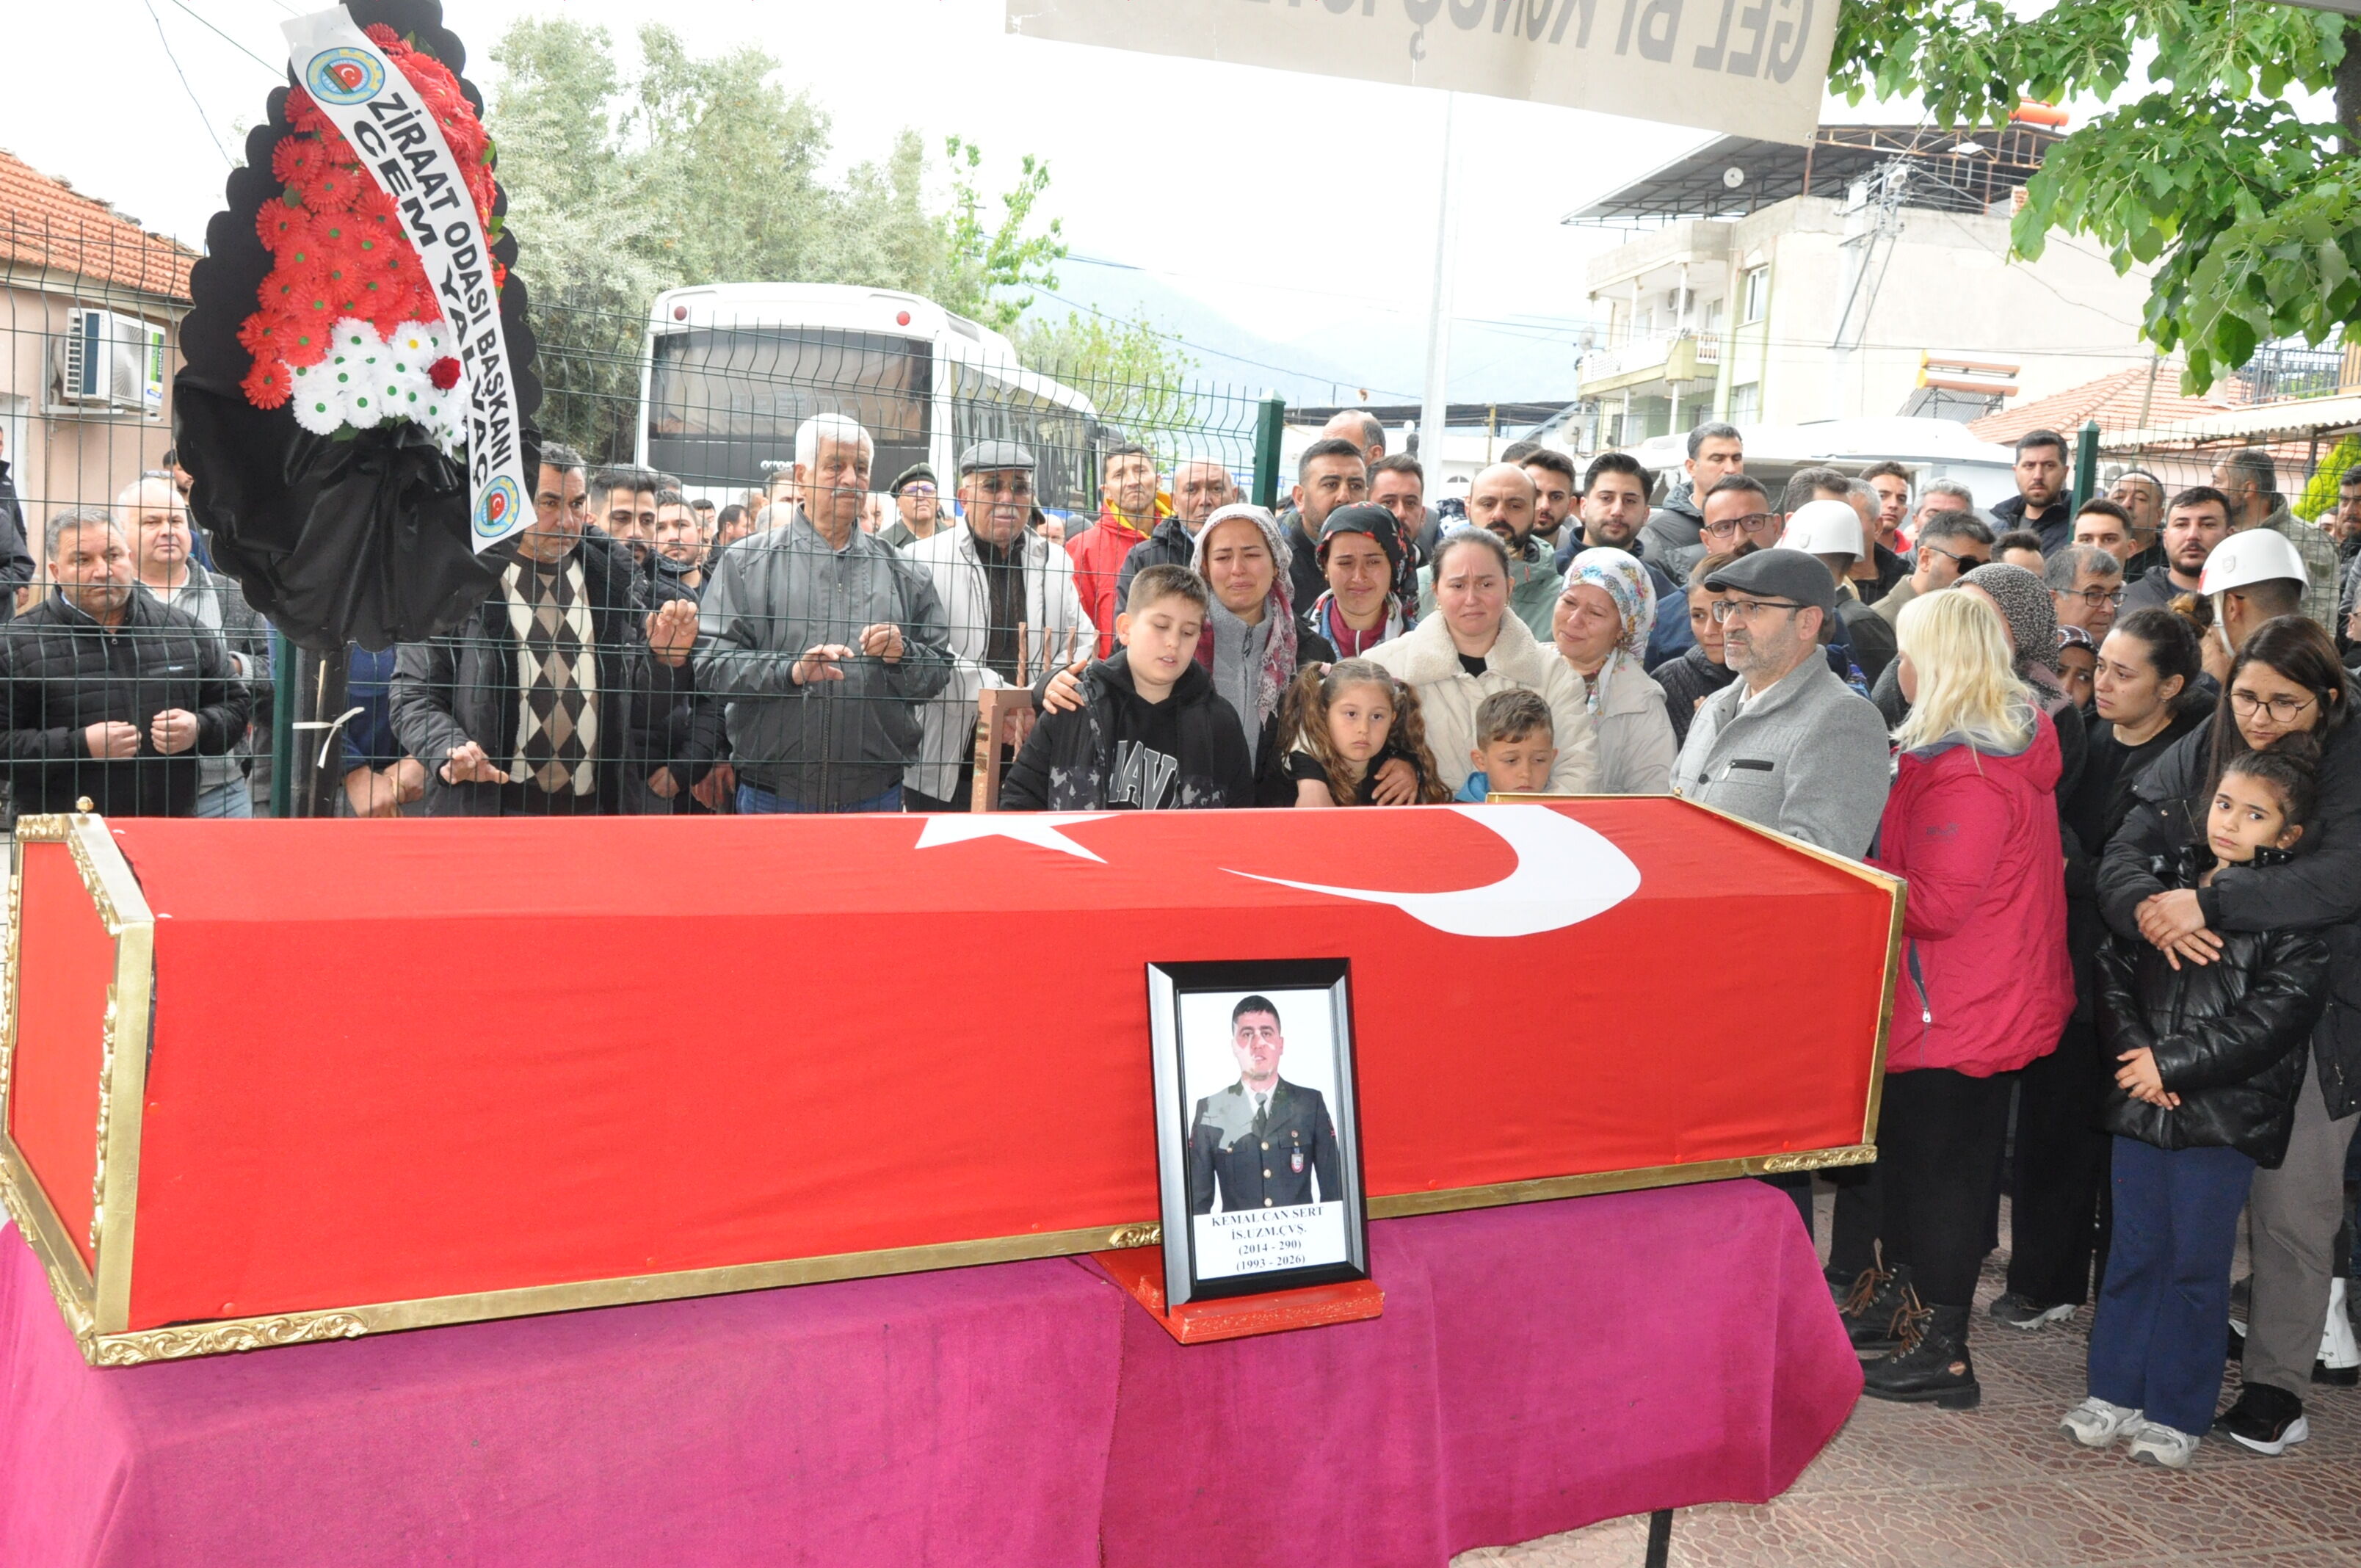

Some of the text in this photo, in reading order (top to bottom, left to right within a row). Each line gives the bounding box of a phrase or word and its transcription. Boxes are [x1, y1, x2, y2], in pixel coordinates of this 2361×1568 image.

[366, 92, 512, 472] ZİRAAT ODASI BAŞKANI
[353, 120, 488, 489] CEM YALVAÇ
[1212, 1206, 1324, 1227] KEMAL CAN SERT
[1238, 1243, 1268, 1256] (2014
[1279, 1238, 1302, 1251] 290)
[1236, 1257, 1266, 1272] (1993
[1277, 1254, 1305, 1266] 2026)
